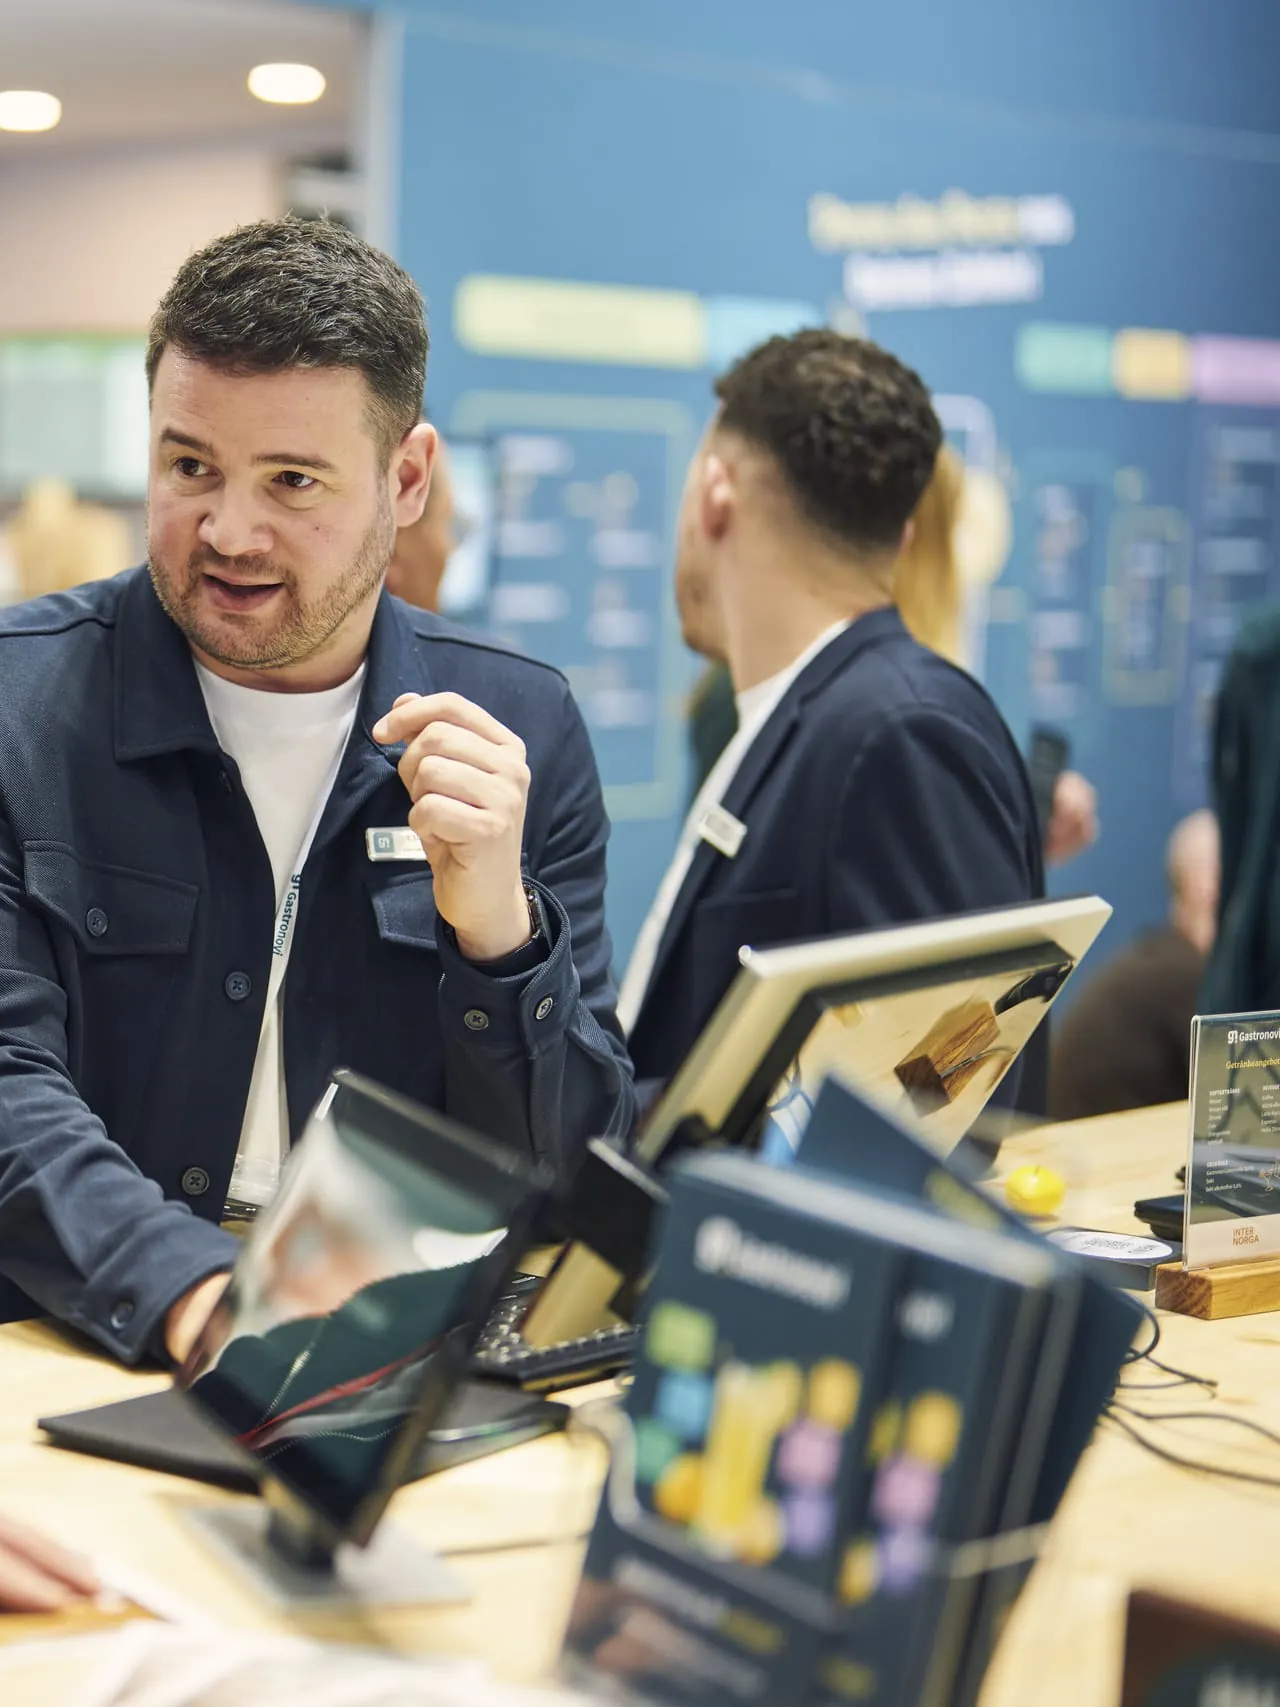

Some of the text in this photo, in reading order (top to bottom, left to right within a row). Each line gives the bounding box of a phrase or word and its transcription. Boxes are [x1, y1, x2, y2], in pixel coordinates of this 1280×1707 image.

[272, 892, 300, 957] Gastronovi
[1233, 1226, 1255, 1237] INTER
[1232, 1235, 1260, 1246] NORGA
